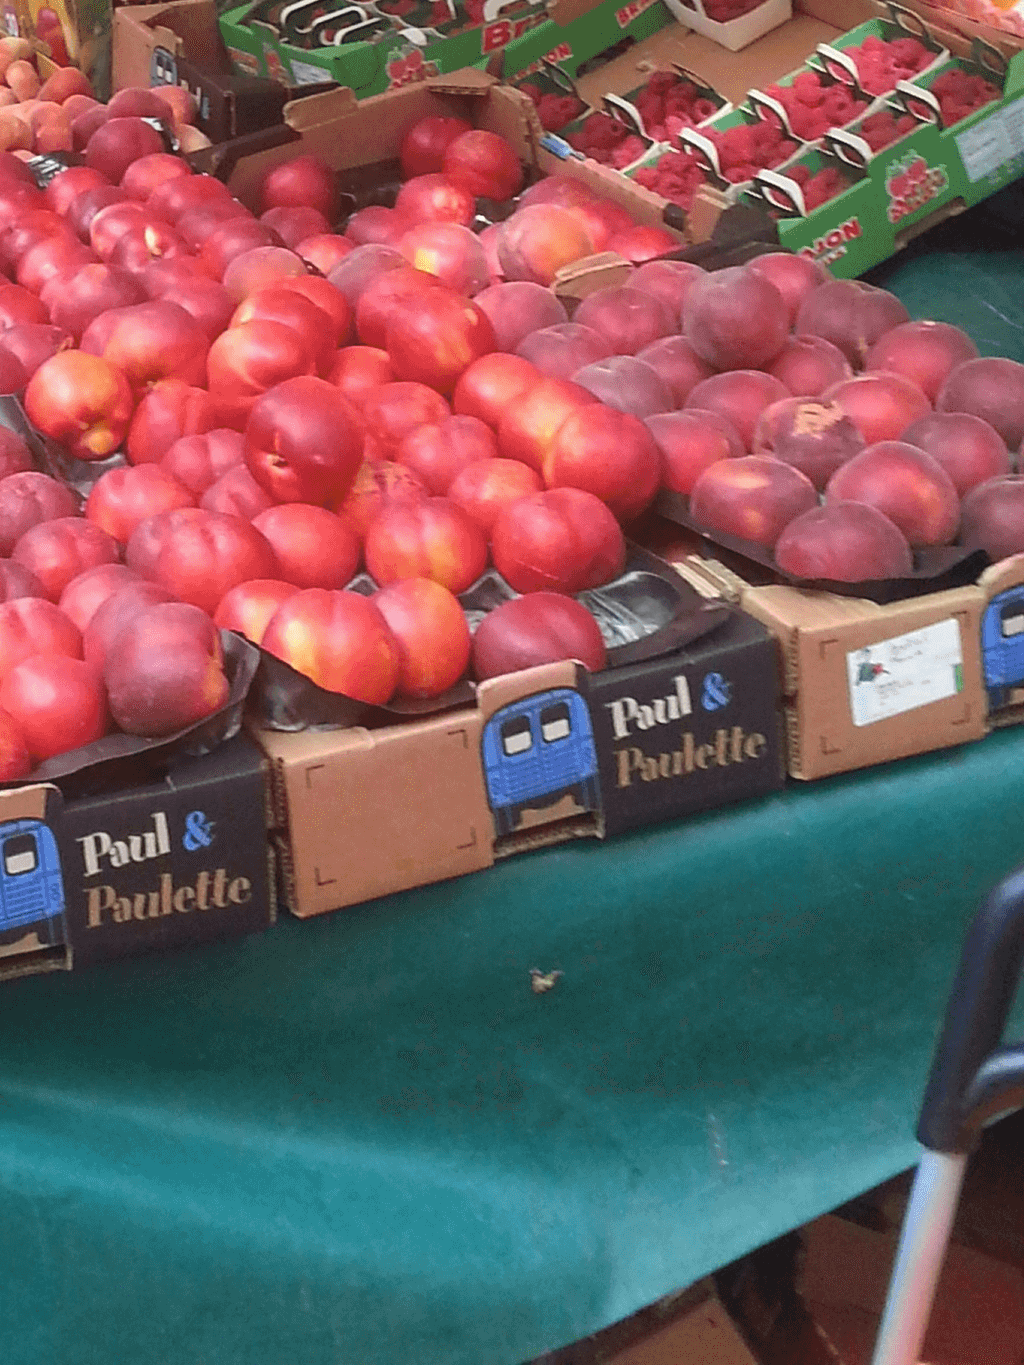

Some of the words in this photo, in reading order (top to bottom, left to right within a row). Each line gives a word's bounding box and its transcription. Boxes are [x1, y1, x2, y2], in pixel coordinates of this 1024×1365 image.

[604, 675, 693, 740] Paul
[701, 672, 733, 711] &
[613, 726, 766, 788] Paulette
[75, 811, 171, 877] Paul
[182, 810, 217, 851] &
[83, 868, 252, 928] Paulette
